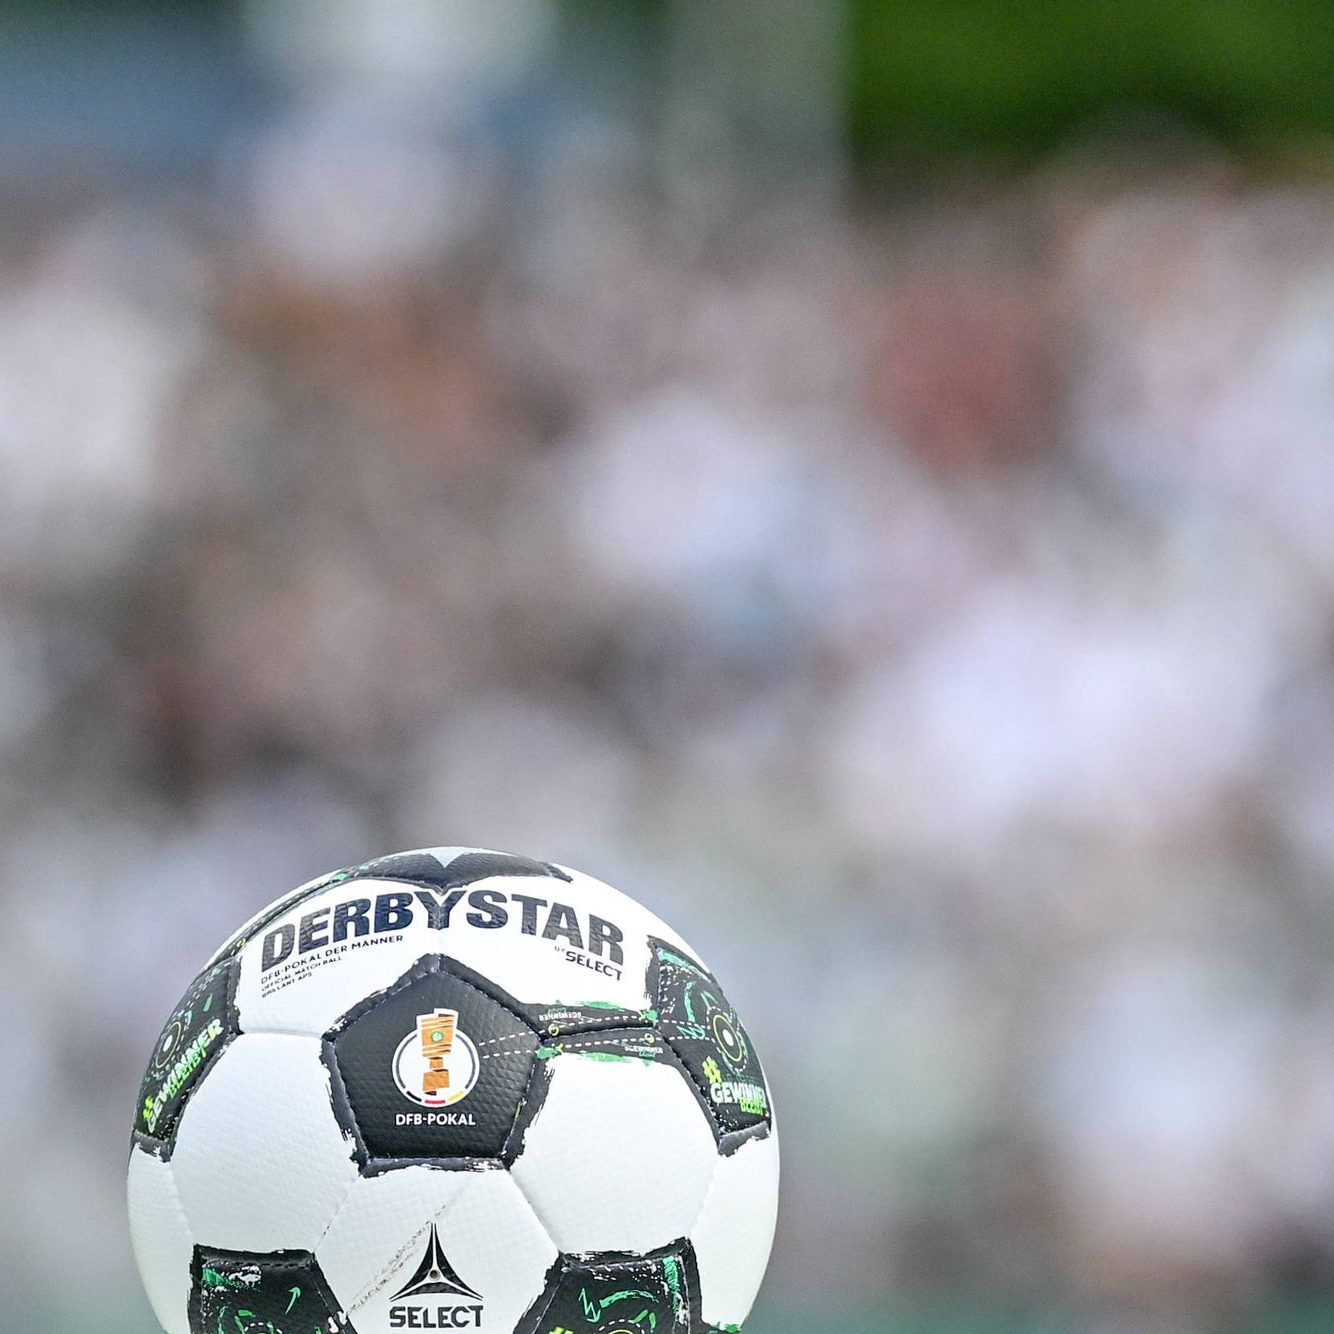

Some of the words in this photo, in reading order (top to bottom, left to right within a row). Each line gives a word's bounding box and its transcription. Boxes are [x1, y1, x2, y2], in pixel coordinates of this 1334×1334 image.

[261, 889, 624, 972] DERBYSTAR
[261, 953, 322, 985] DFB-POKAL
[325, 945, 348, 957] DER
[294, 962, 321, 976] MATCH
[323, 956, 342, 965] BALL
[565, 951, 623, 981] SELECT
[395, 1113, 476, 1126] DFB-POKAL
[389, 1305, 484, 1328] SELECT
